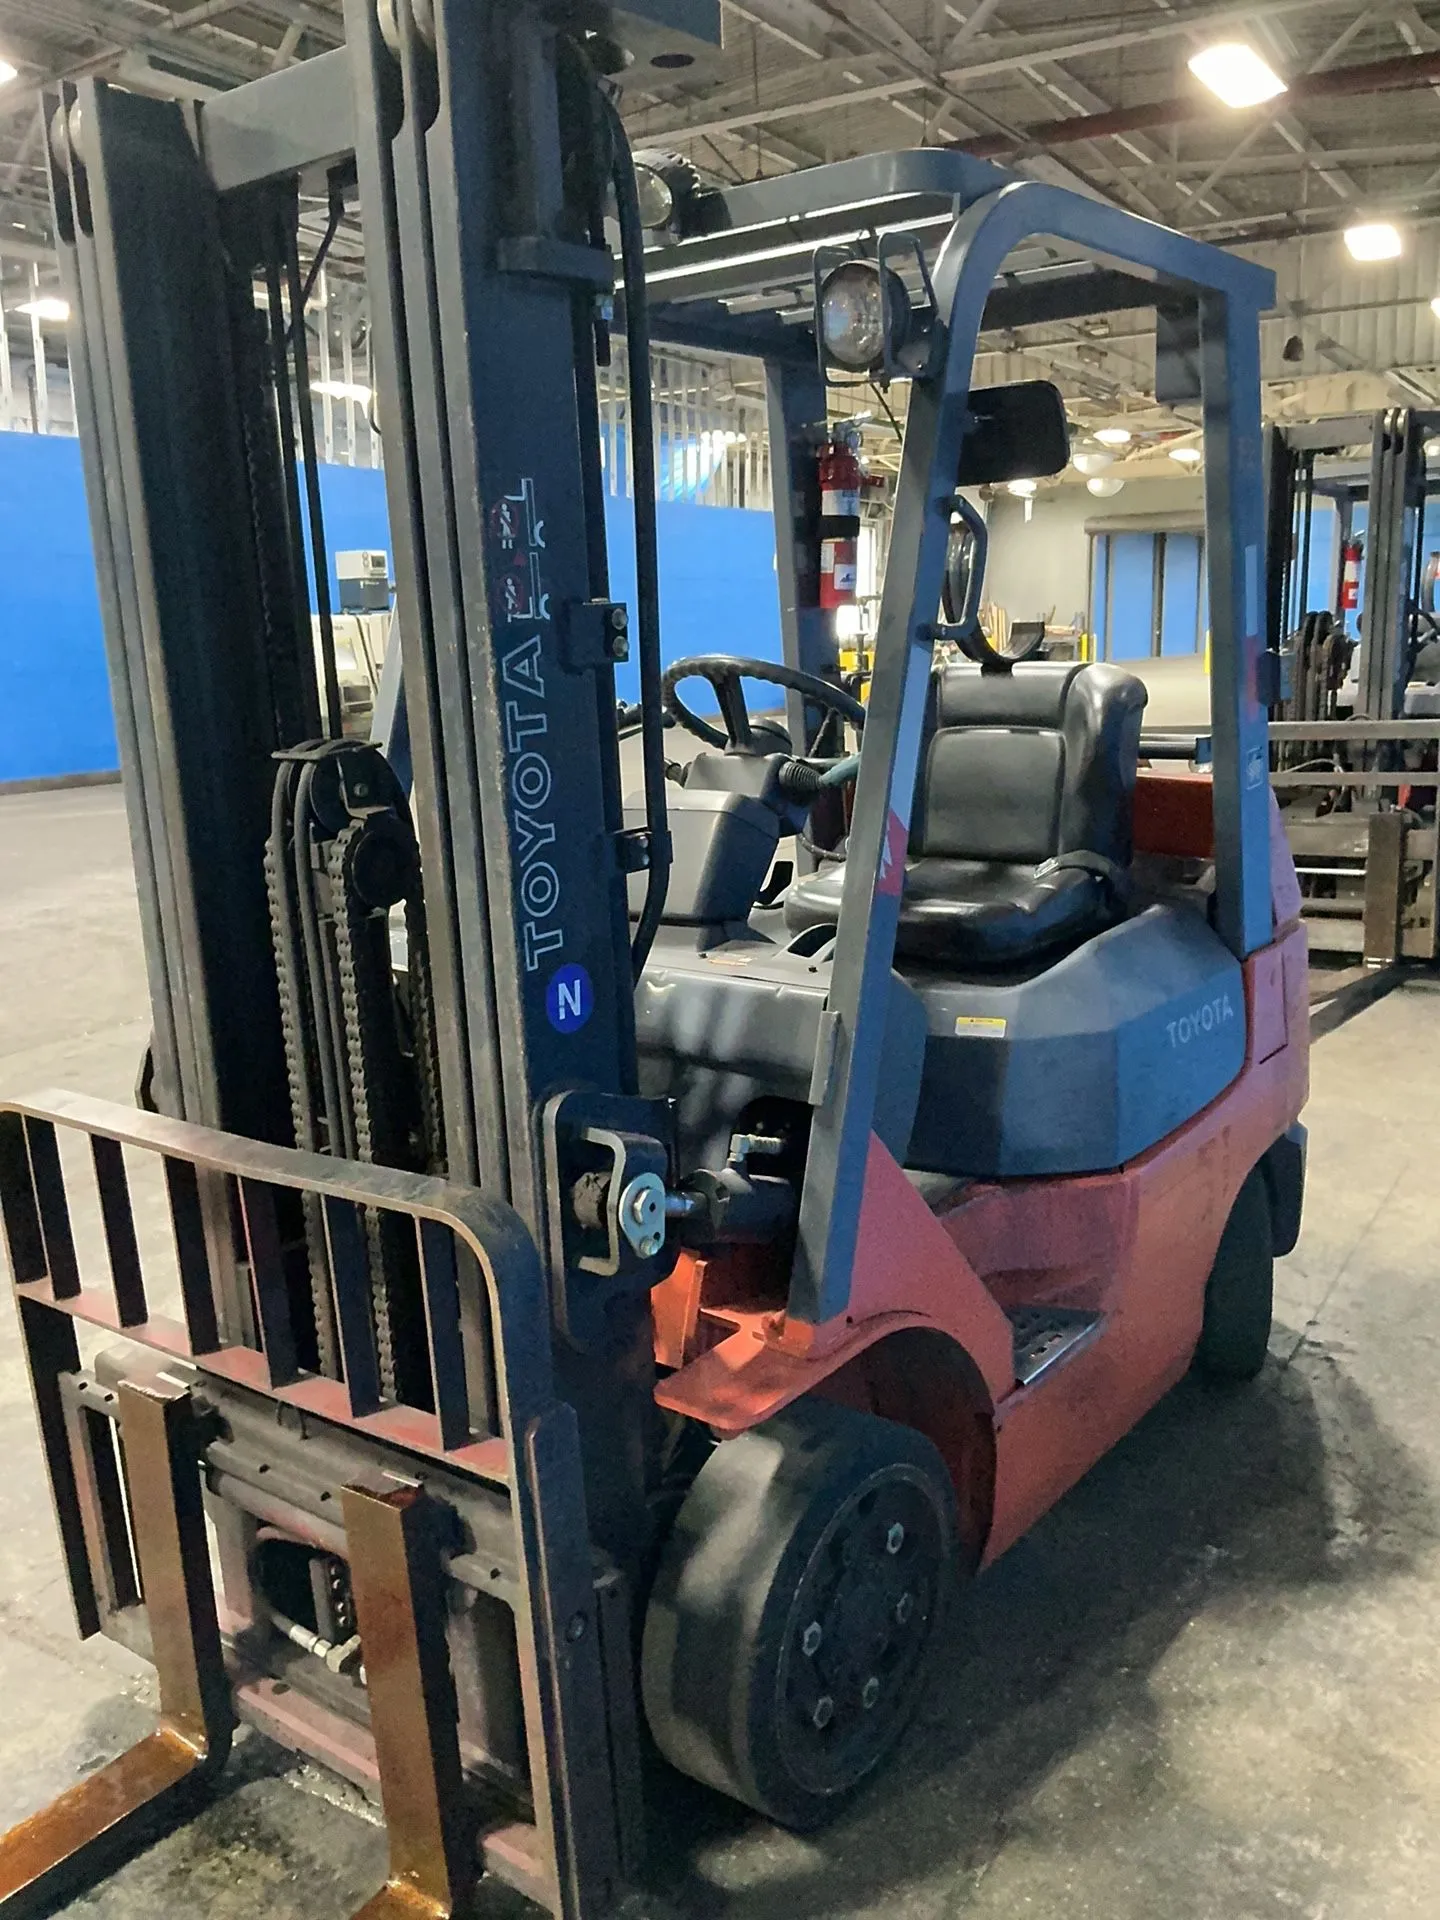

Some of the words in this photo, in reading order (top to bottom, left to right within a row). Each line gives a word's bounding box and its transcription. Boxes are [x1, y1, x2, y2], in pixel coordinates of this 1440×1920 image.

[502, 634, 564, 972] TOYOTA
[556, 978, 582, 1021] N
[1166, 992, 1234, 1049] TOYOTA
